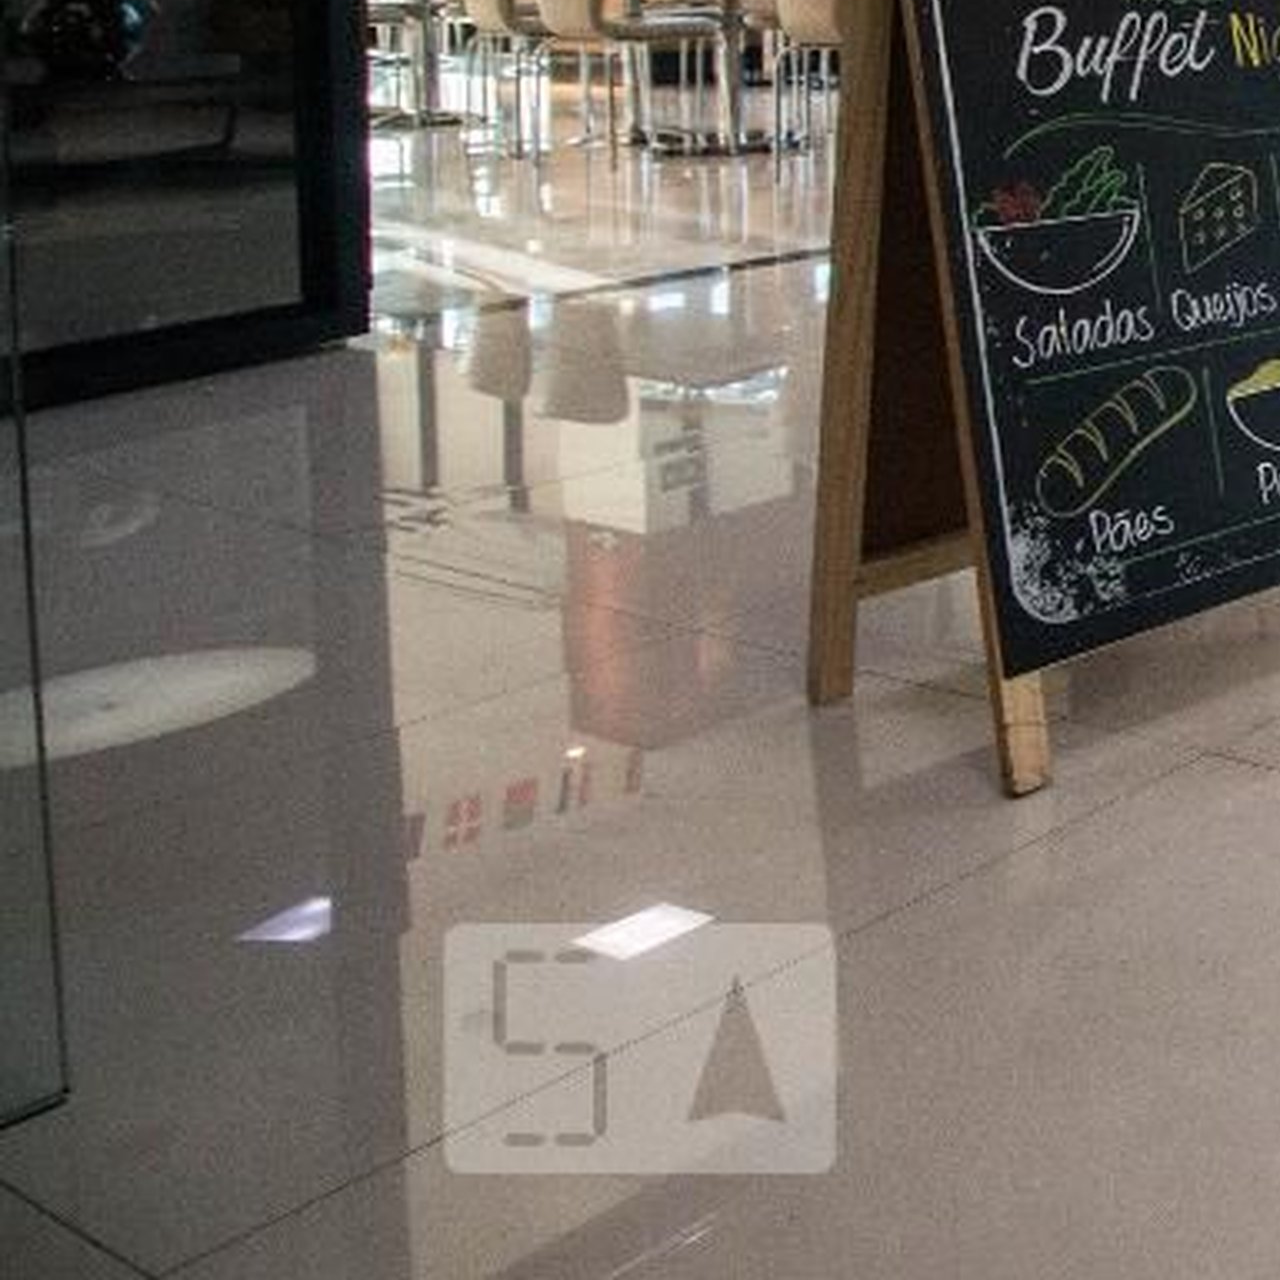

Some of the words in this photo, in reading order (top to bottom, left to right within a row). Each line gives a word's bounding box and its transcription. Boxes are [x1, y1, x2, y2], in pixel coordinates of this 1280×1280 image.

[1016, 6, 1220, 103] Buffet
[1011, 302, 1155, 370] Saladas
[1171, 280, 1279, 332] Queijos
[1087, 505, 1176, 556] Pães
